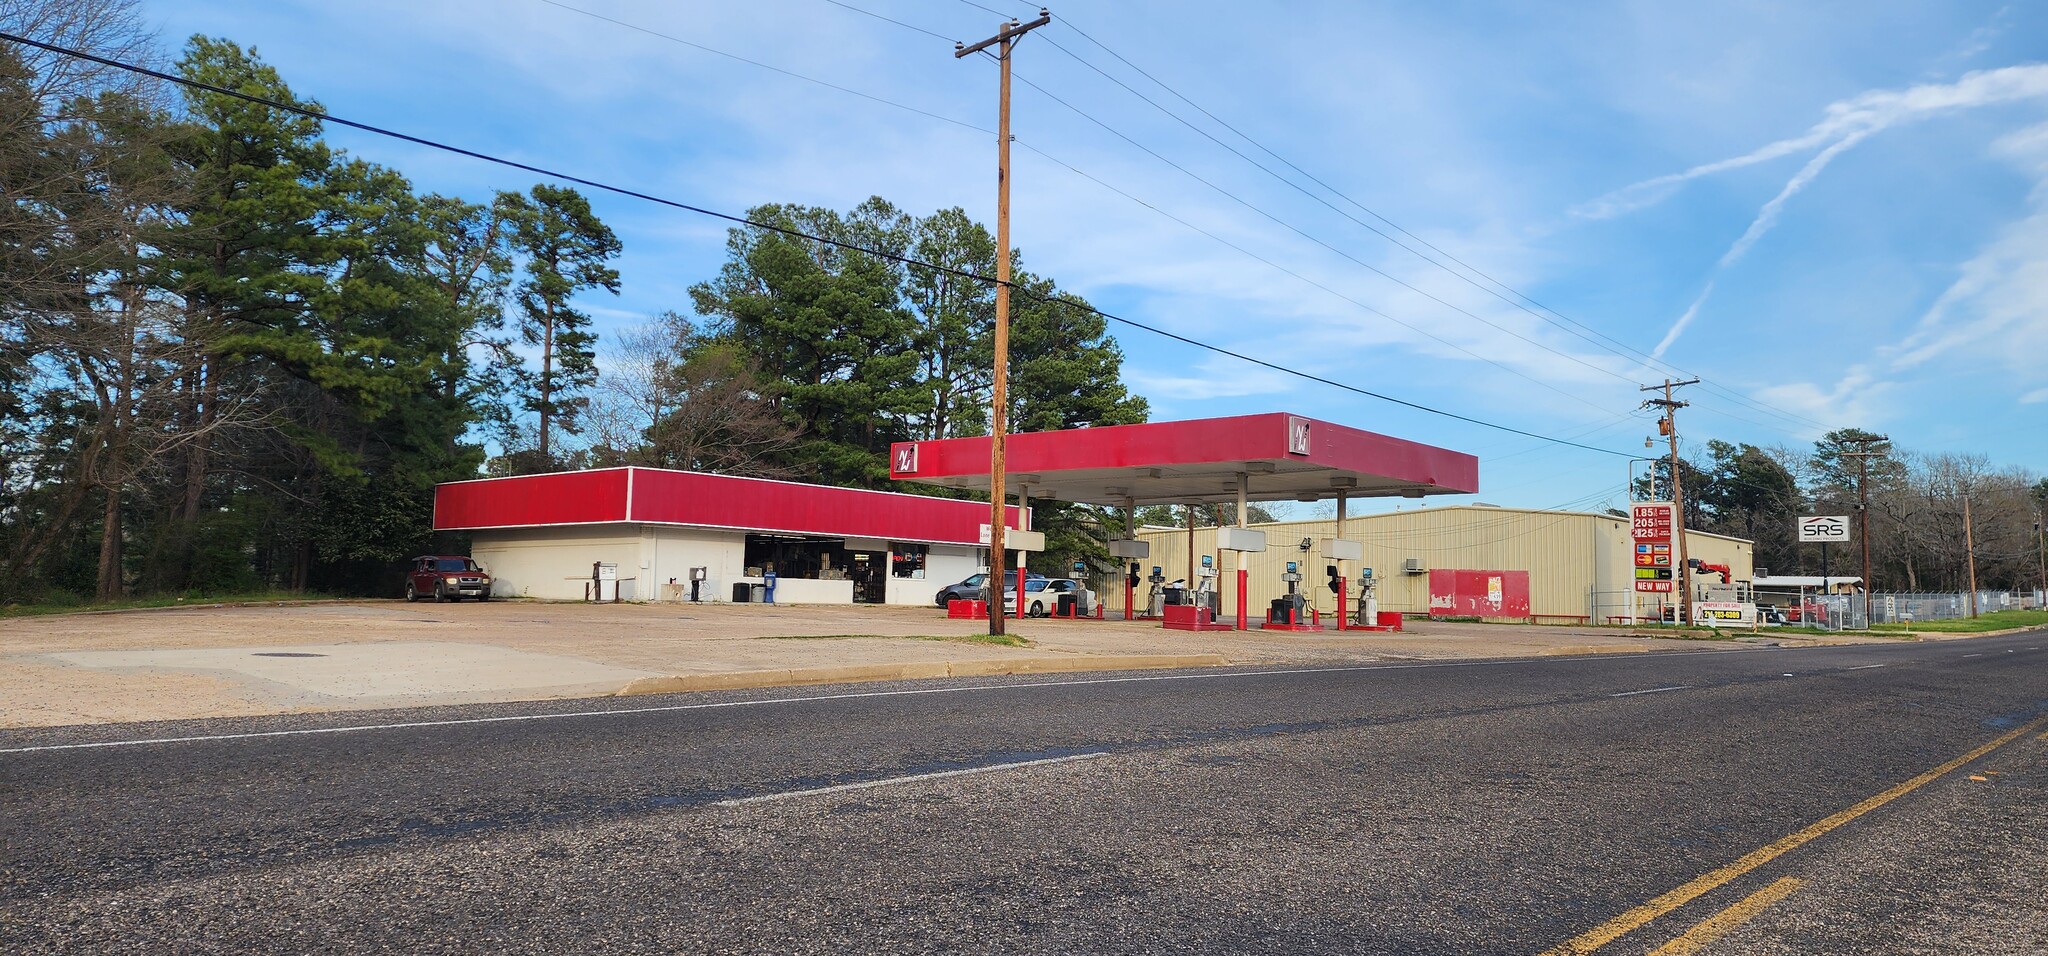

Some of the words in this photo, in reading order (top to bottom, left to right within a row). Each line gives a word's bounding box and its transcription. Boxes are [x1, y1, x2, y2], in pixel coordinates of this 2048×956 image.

[1635, 508, 1653, 517] 1.85
[1804, 525, 1844, 536] SRS
[1637, 581, 1653, 590] NEW
[1655, 582, 1670, 591] WAY
